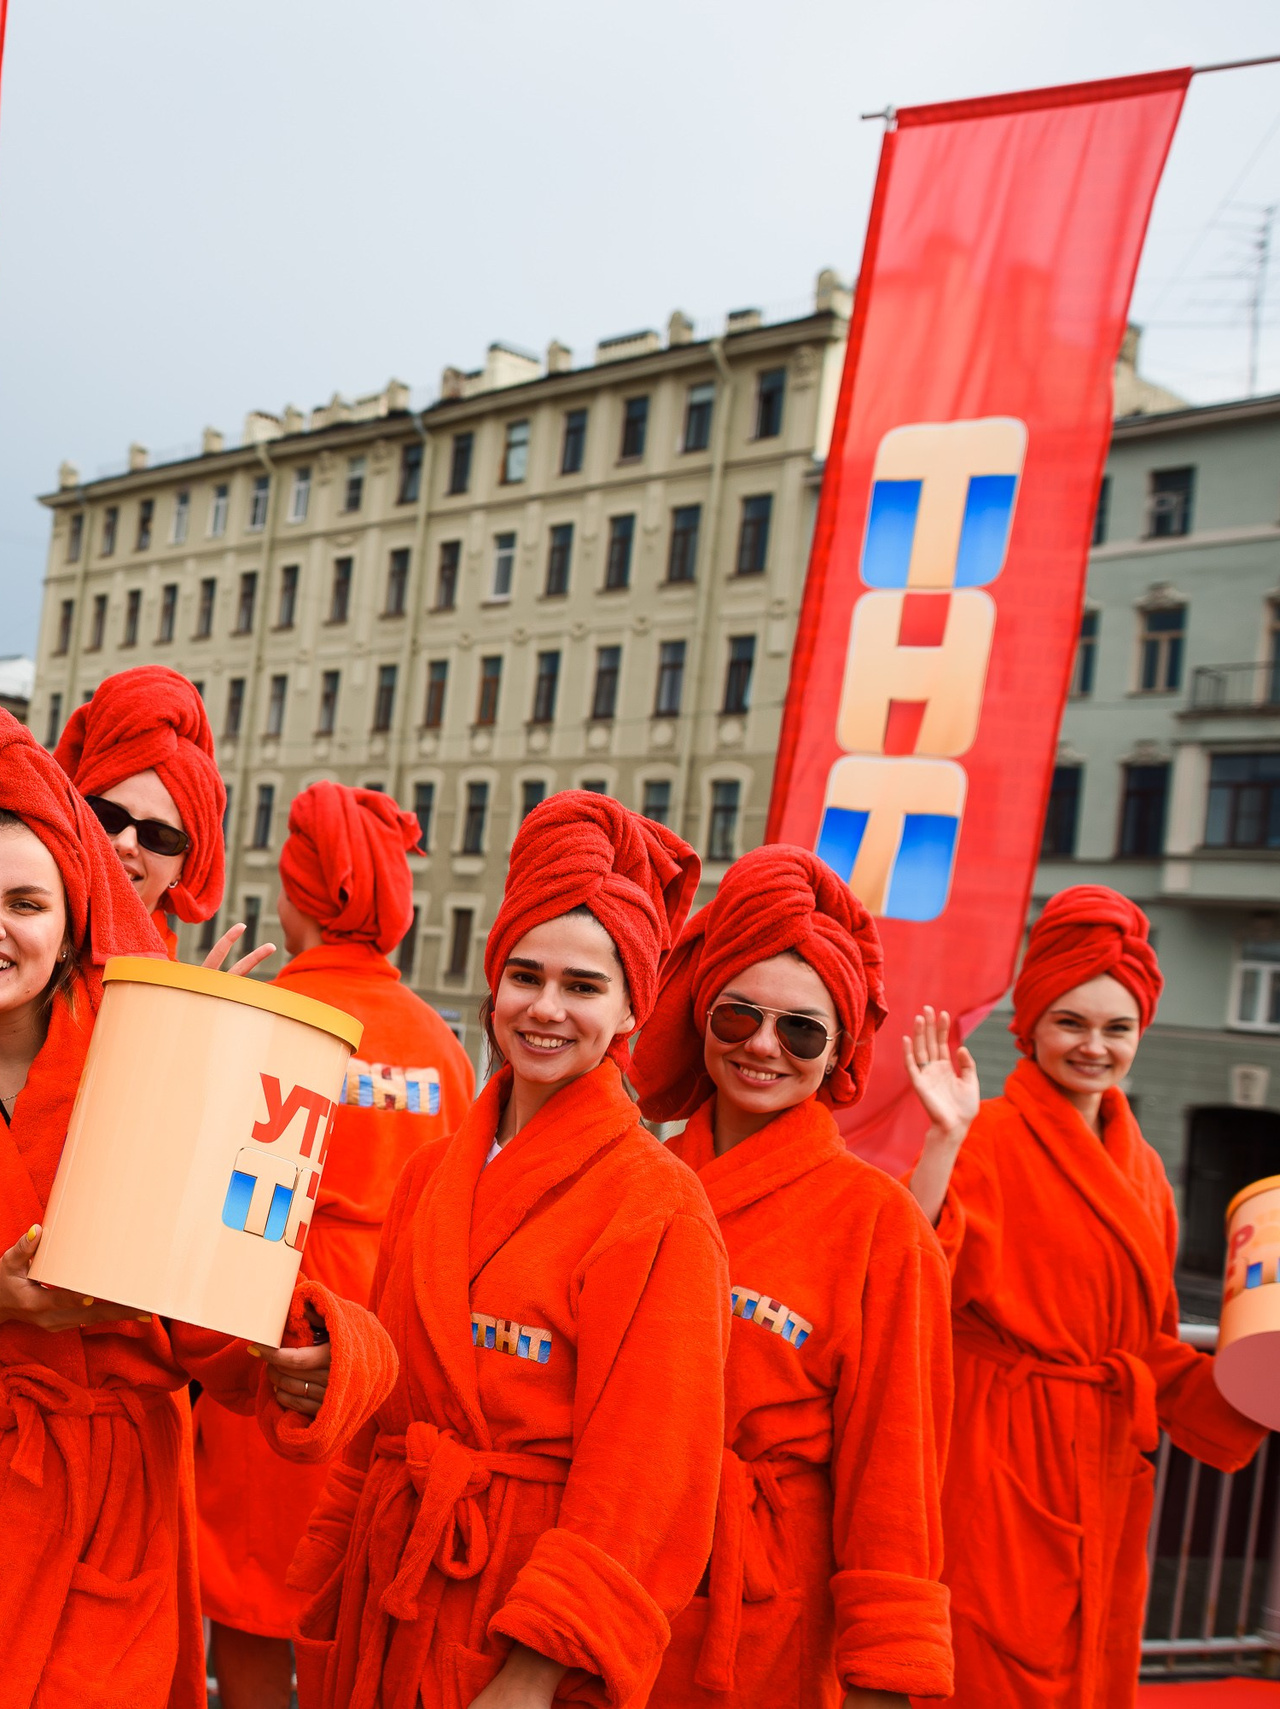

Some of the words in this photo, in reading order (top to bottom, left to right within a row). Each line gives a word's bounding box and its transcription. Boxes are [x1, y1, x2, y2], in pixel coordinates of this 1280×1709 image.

[815, 415, 1029, 922] ТНТ
[339, 1056, 441, 1116] ТНТ
[471, 1311, 552, 1364] ТНТ
[730, 1285, 814, 1350] ТНТ
